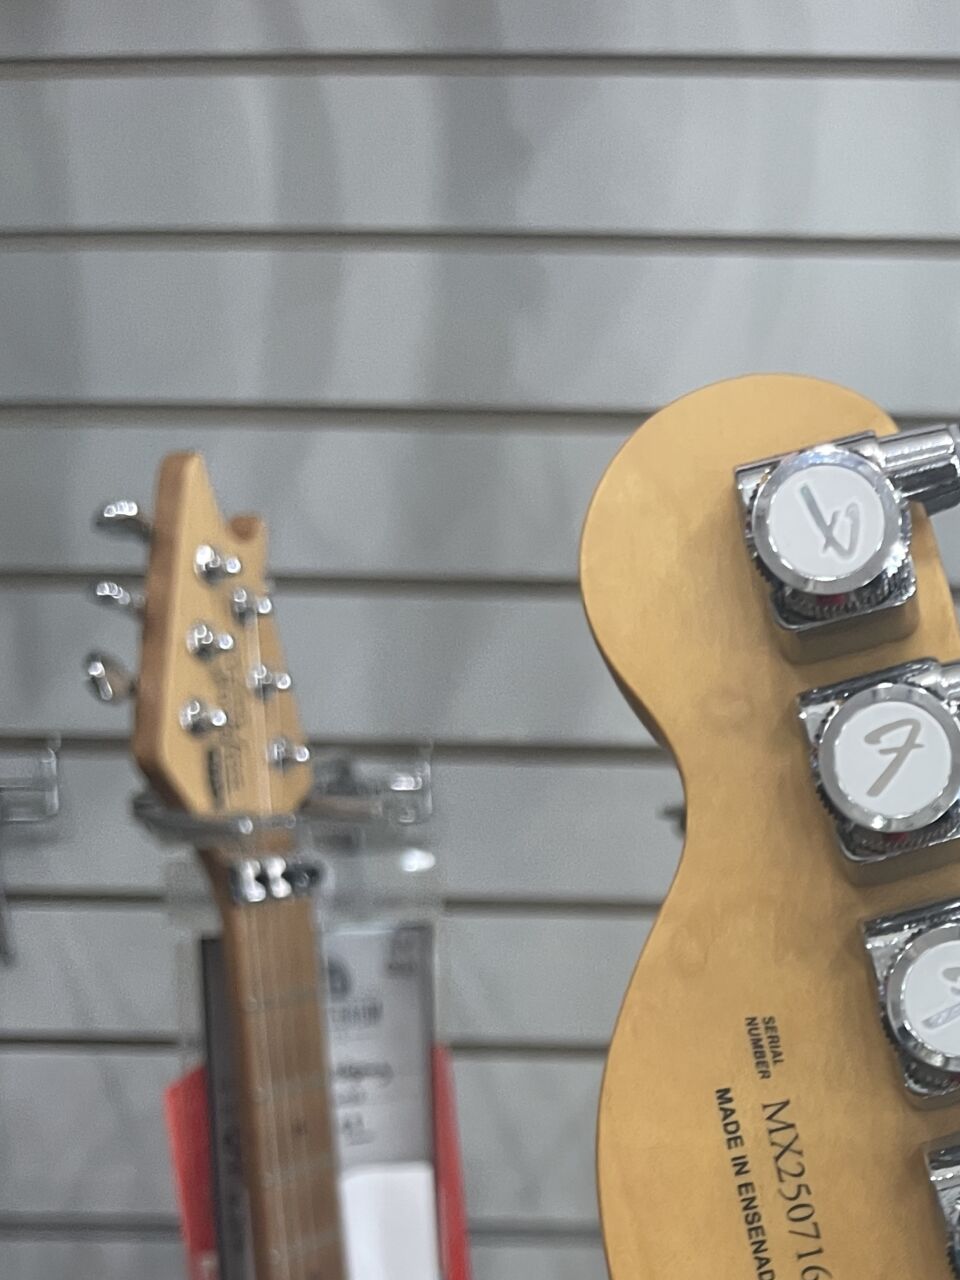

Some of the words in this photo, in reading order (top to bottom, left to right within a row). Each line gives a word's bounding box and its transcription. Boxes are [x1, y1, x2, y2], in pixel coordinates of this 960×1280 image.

[745, 1017, 770, 1080] NUMBER
[763, 1016, 784, 1066] SERIAL
[715, 1087, 744, 1150] MADE
[731, 1154, 751, 1177] IN
